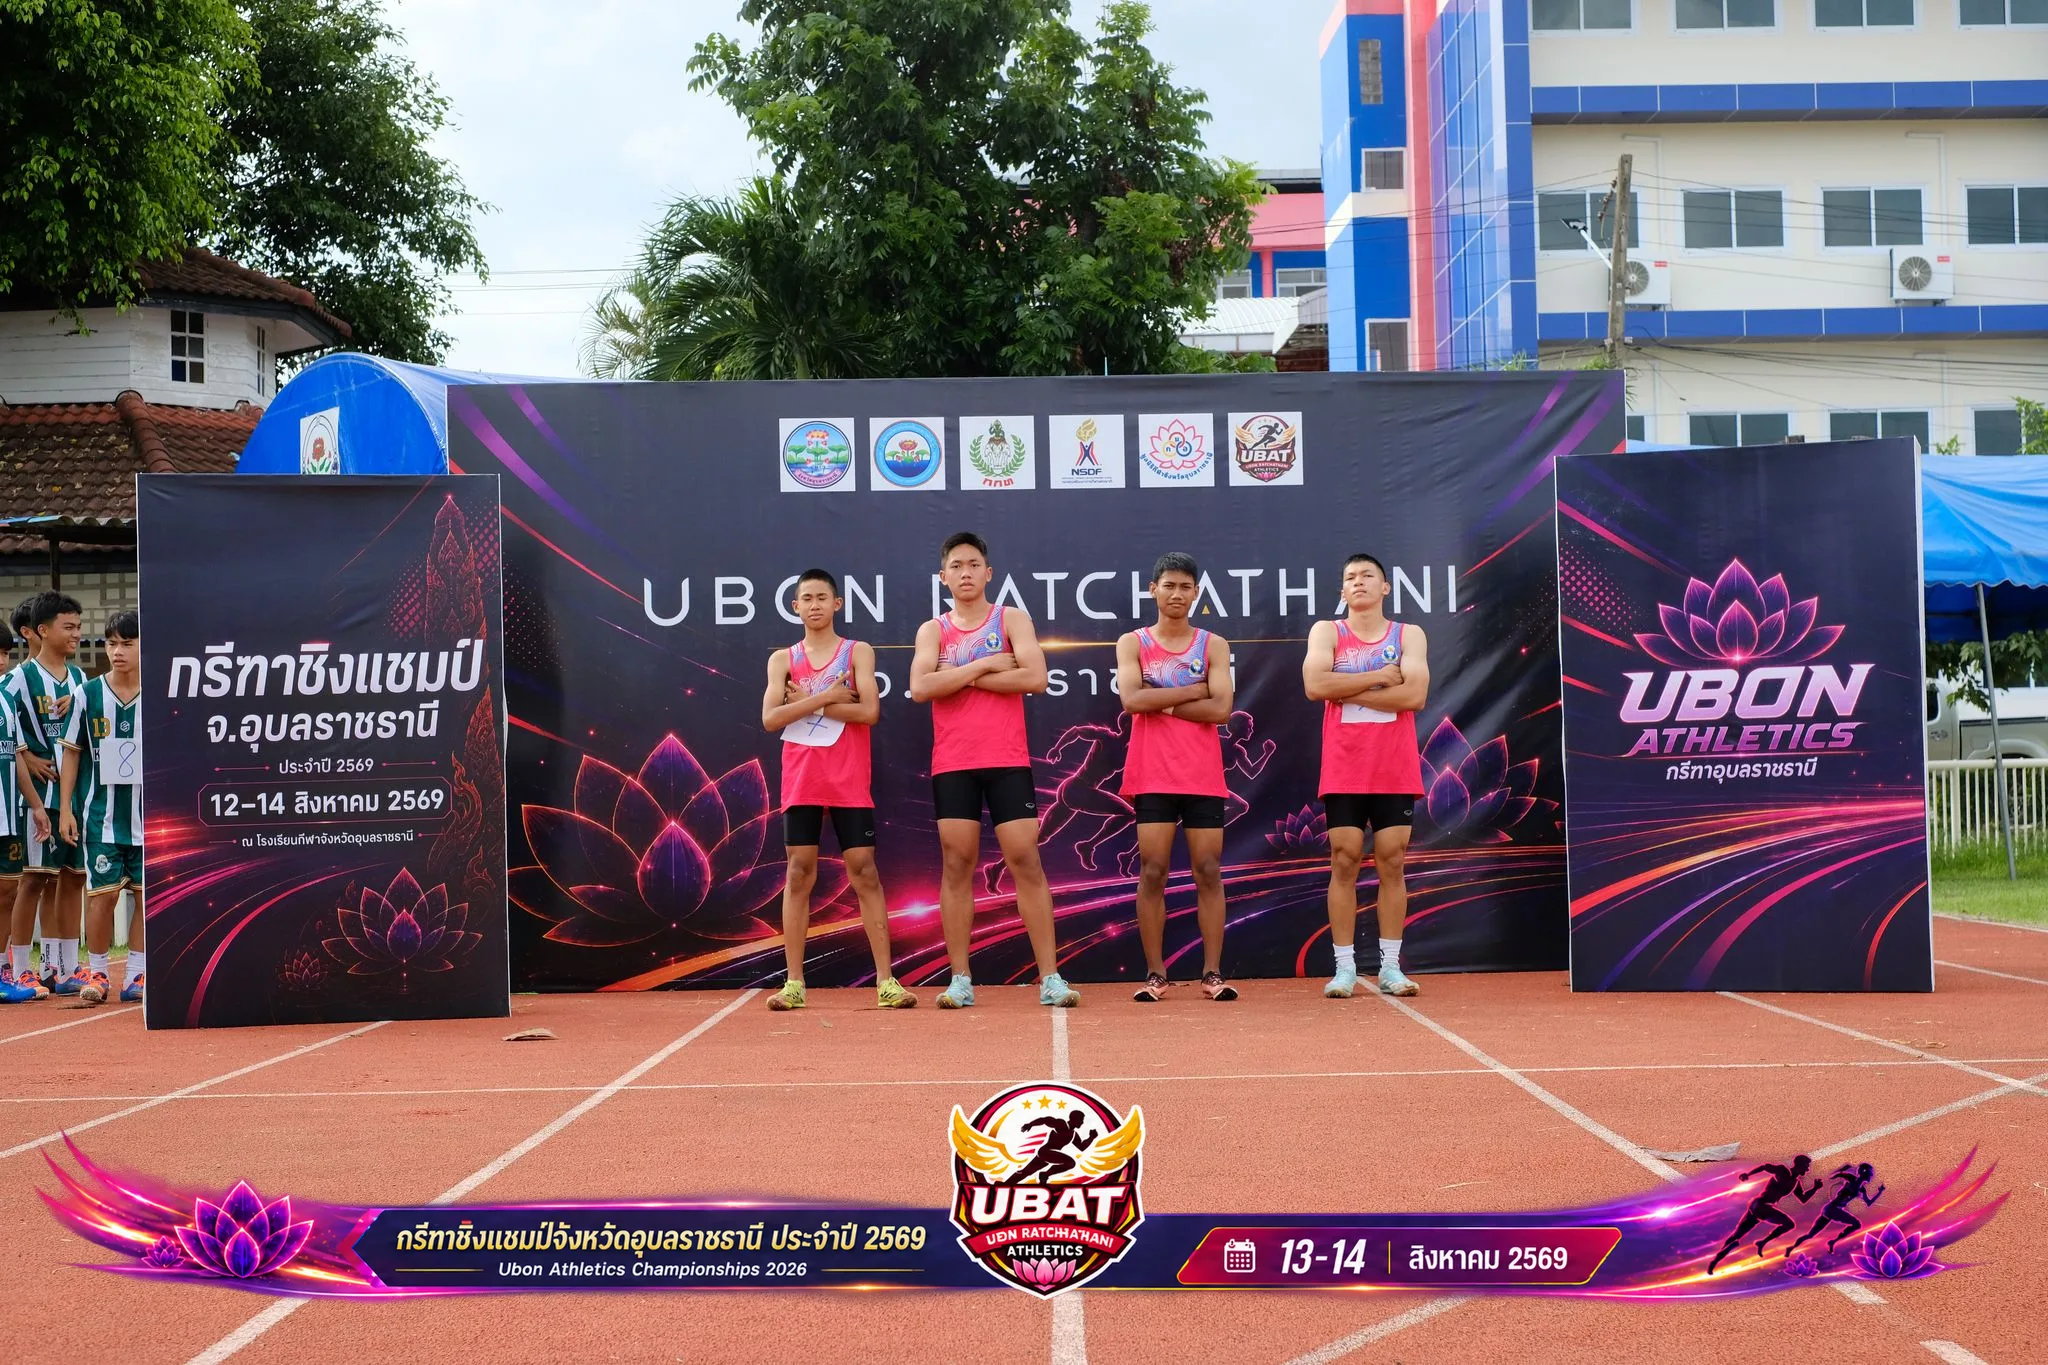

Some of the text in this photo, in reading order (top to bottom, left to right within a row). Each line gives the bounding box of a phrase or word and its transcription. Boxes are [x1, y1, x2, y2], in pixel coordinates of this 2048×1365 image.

[1240, 449, 1292, 463] UBAT
[1071, 468, 1103, 476] NSDF
[167, 638, 484, 699] กรีฑาชิงแชมป์
[1619, 663, 1876, 723] UBON
[92, 717, 111, 737] 13
[207, 699, 440, 753] จ.อุบลราชธานี
[1619, 722, 1867, 757] ATHLETICS
[118, 741, 137, 778] 8
[278, 758, 374, 774] ประจำปี 2569
[294, 791, 379, 814] สิงหาคม
[387, 788, 444, 811] 2569
[241, 838, 253, 847] ณ
